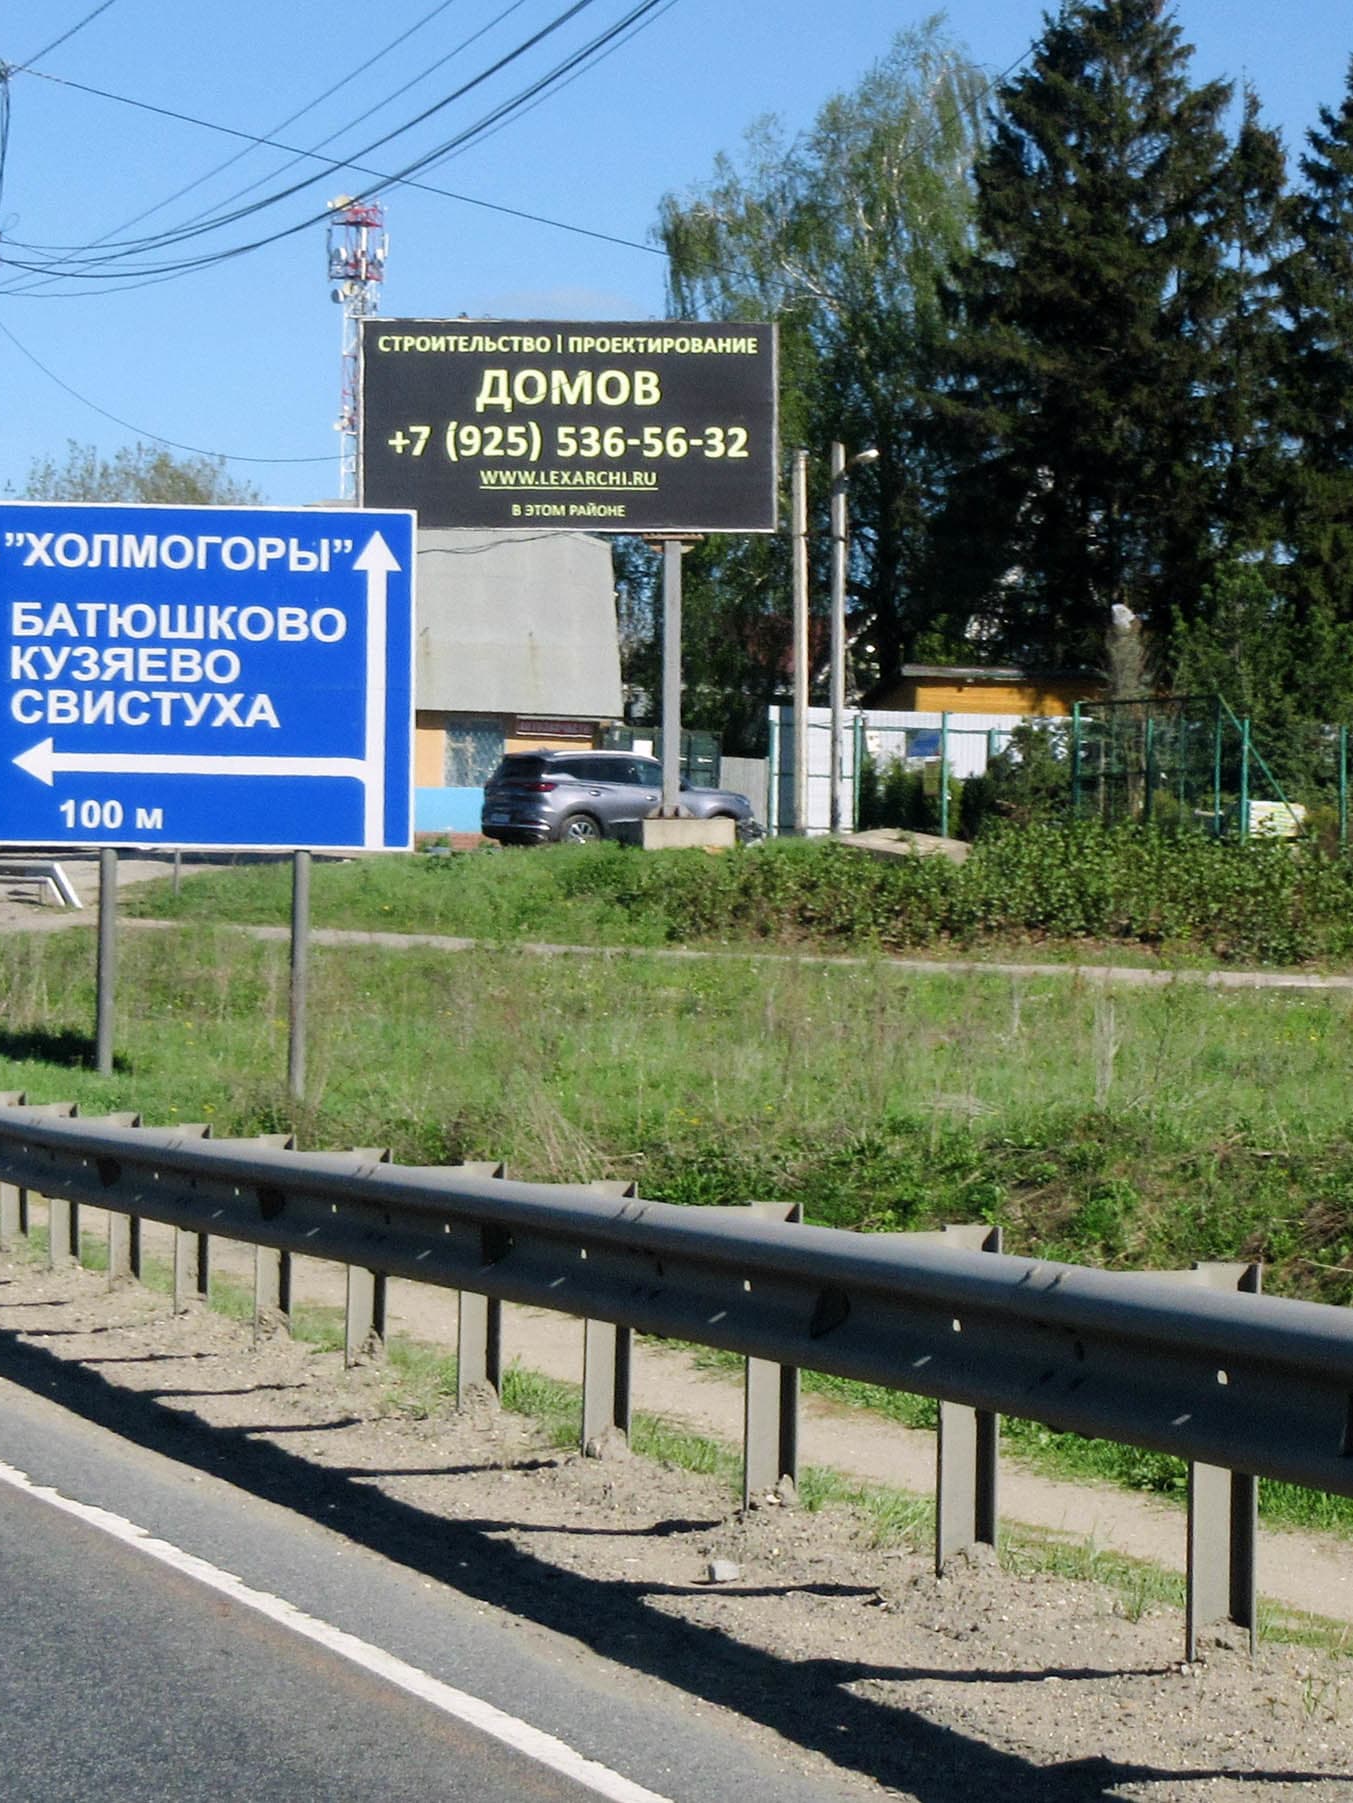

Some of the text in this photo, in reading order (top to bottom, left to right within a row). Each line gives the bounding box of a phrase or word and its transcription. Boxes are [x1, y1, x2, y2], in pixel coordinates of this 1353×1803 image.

[378, 335, 551, 354] СТРОИТЕЛЬСТВО
[568, 336, 758, 355] ПРОЕКТИРОВАНИЕ
[475, 369, 661, 413] ДОМОВ
[387, 421, 749, 462] +7 (925) 536-56-32
[480, 469, 657, 487] WWW.LEXARCHI.RU
[511, 502, 626, 518] В ЭТОМ РАЙОНЕ
[12, 602, 347, 643] БАТЮШКОВО
[10, 646, 241, 684] КУЗЯЕВО
[10, 688, 281, 728] СВИСТУХА
[59, 799, 123, 829] 100
